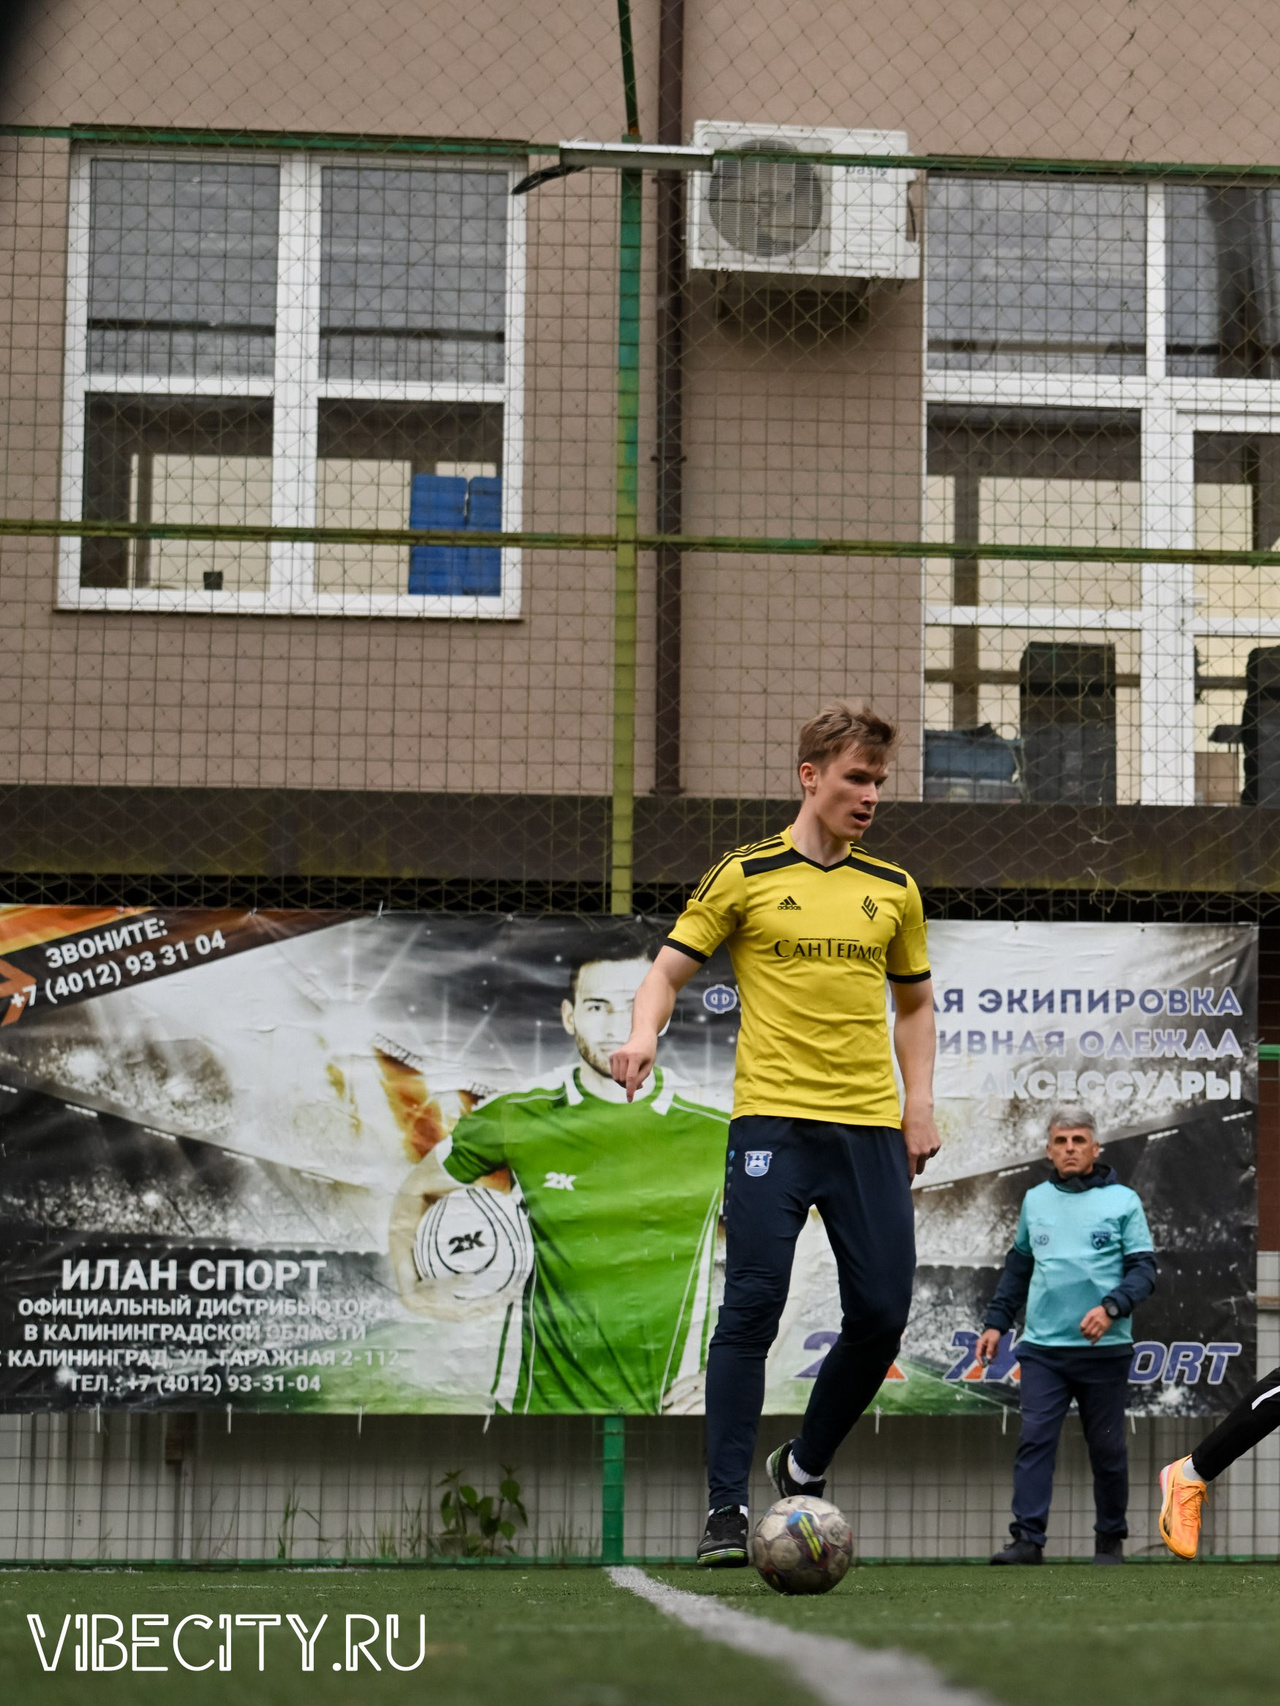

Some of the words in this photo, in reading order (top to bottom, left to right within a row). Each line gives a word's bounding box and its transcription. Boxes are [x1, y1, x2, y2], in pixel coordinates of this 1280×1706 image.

[45, 917, 168, 969] ЗВОНИТЕ:
[10, 985, 37, 1008] +7
[45, 960, 122, 1004] (4012)
[125, 951, 156, 976] 93
[160, 941, 189, 966] 31
[194, 929, 226, 956] 04
[977, 987, 1243, 1015] ЭКИПИРОВКА
[1078, 1028, 1243, 1060] ОДЕЖДА
[979, 1070, 1242, 1100] АКСЕССУАРЫ
[543, 1172, 577, 1191] 2K
[448, 1230, 486, 1256] 2K
[61, 1258, 177, 1291] ИЛАН
[188, 1258, 327, 1291] СПОРТ
[18, 1294, 192, 1319] ОФИЦИАЛЬНЫЙ
[196, 1297, 373, 1319] ДИСТРИБЬЮТОР
[24, 1323, 38, 1341] В
[43, 1320, 261, 1345] КАЛИНИНГРАДСКОЙ
[266, 1322, 367, 1342] ОБЛАСТИ
[219, 1348, 336, 1367] ГАРАЖНАЯ
[341, 1349, 400, 1367] 2-112
[70, 1373, 122, 1392] ТЕЛ.:
[127, 1374, 151, 1392] +7
[157, 1373, 222, 1396] (4012)
[227, 1373, 321, 1392] 93-31-04
